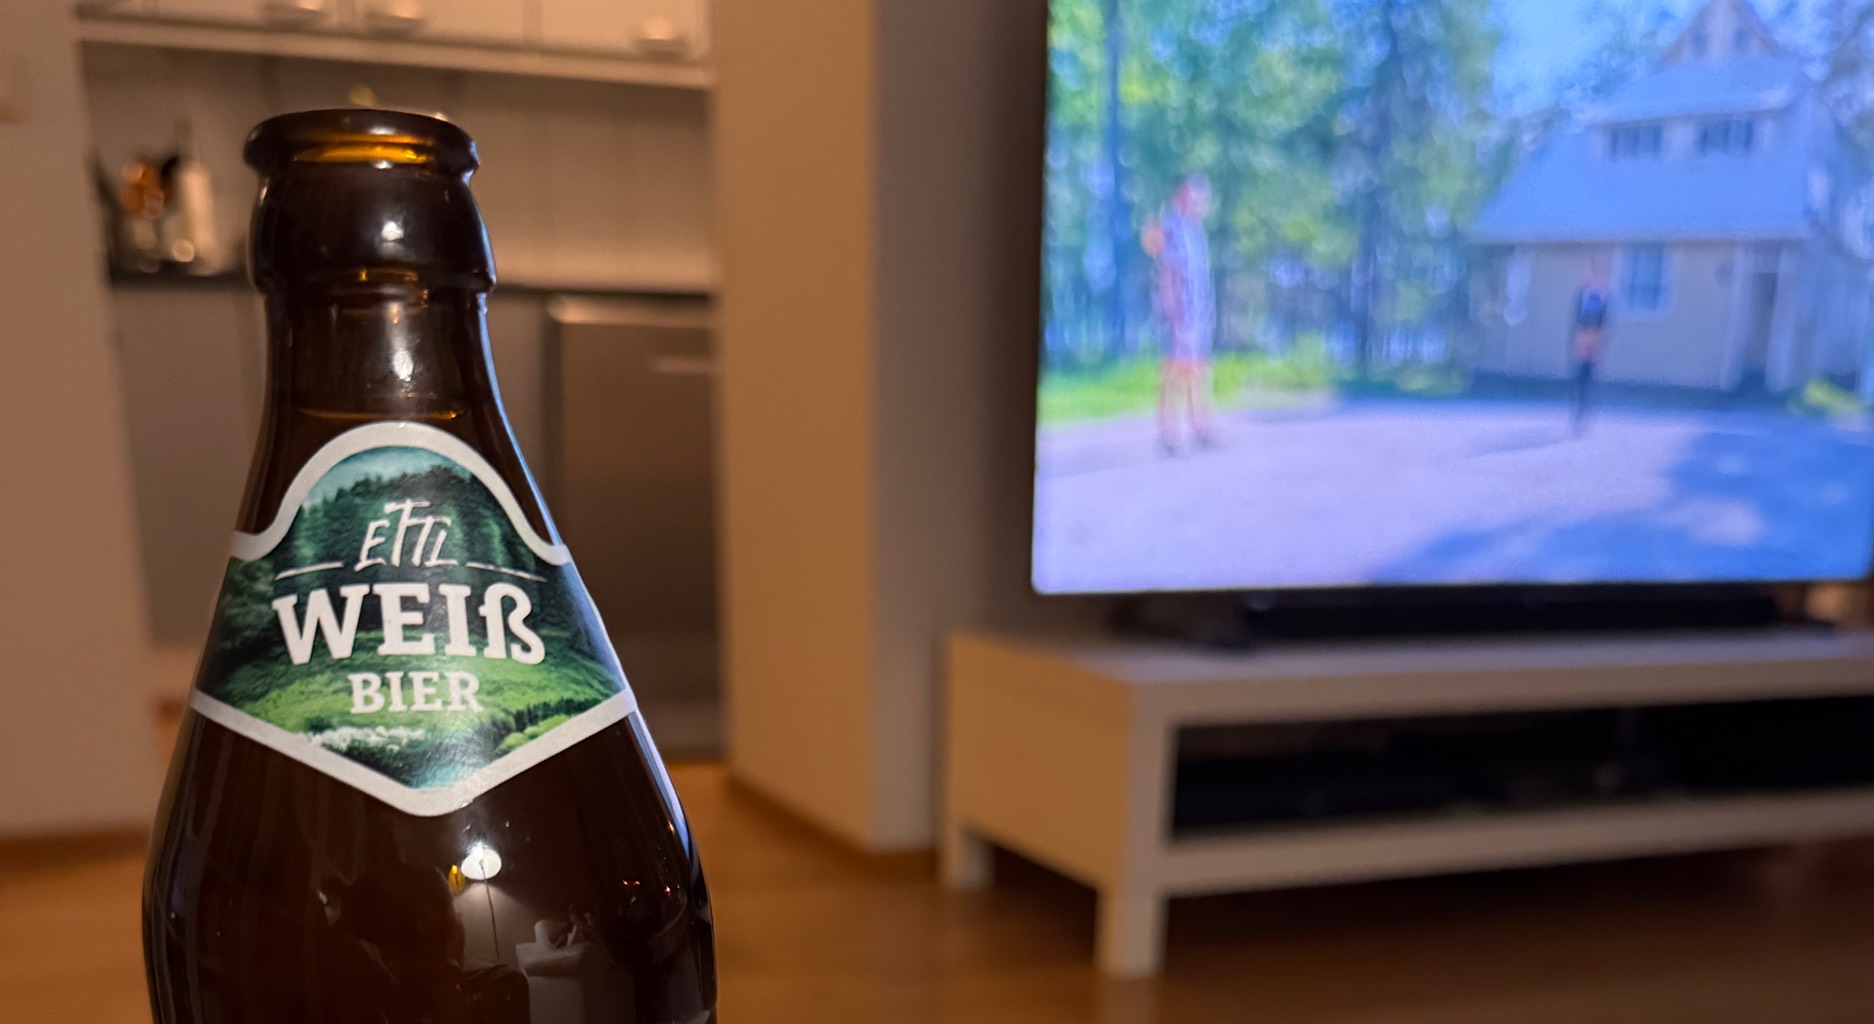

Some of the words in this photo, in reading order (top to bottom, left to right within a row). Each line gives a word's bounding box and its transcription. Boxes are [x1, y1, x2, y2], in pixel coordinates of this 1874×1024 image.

[354, 498, 459, 572] ETTL
[271, 582, 546, 666] WEIß
[347, 671, 484, 715] BIER
